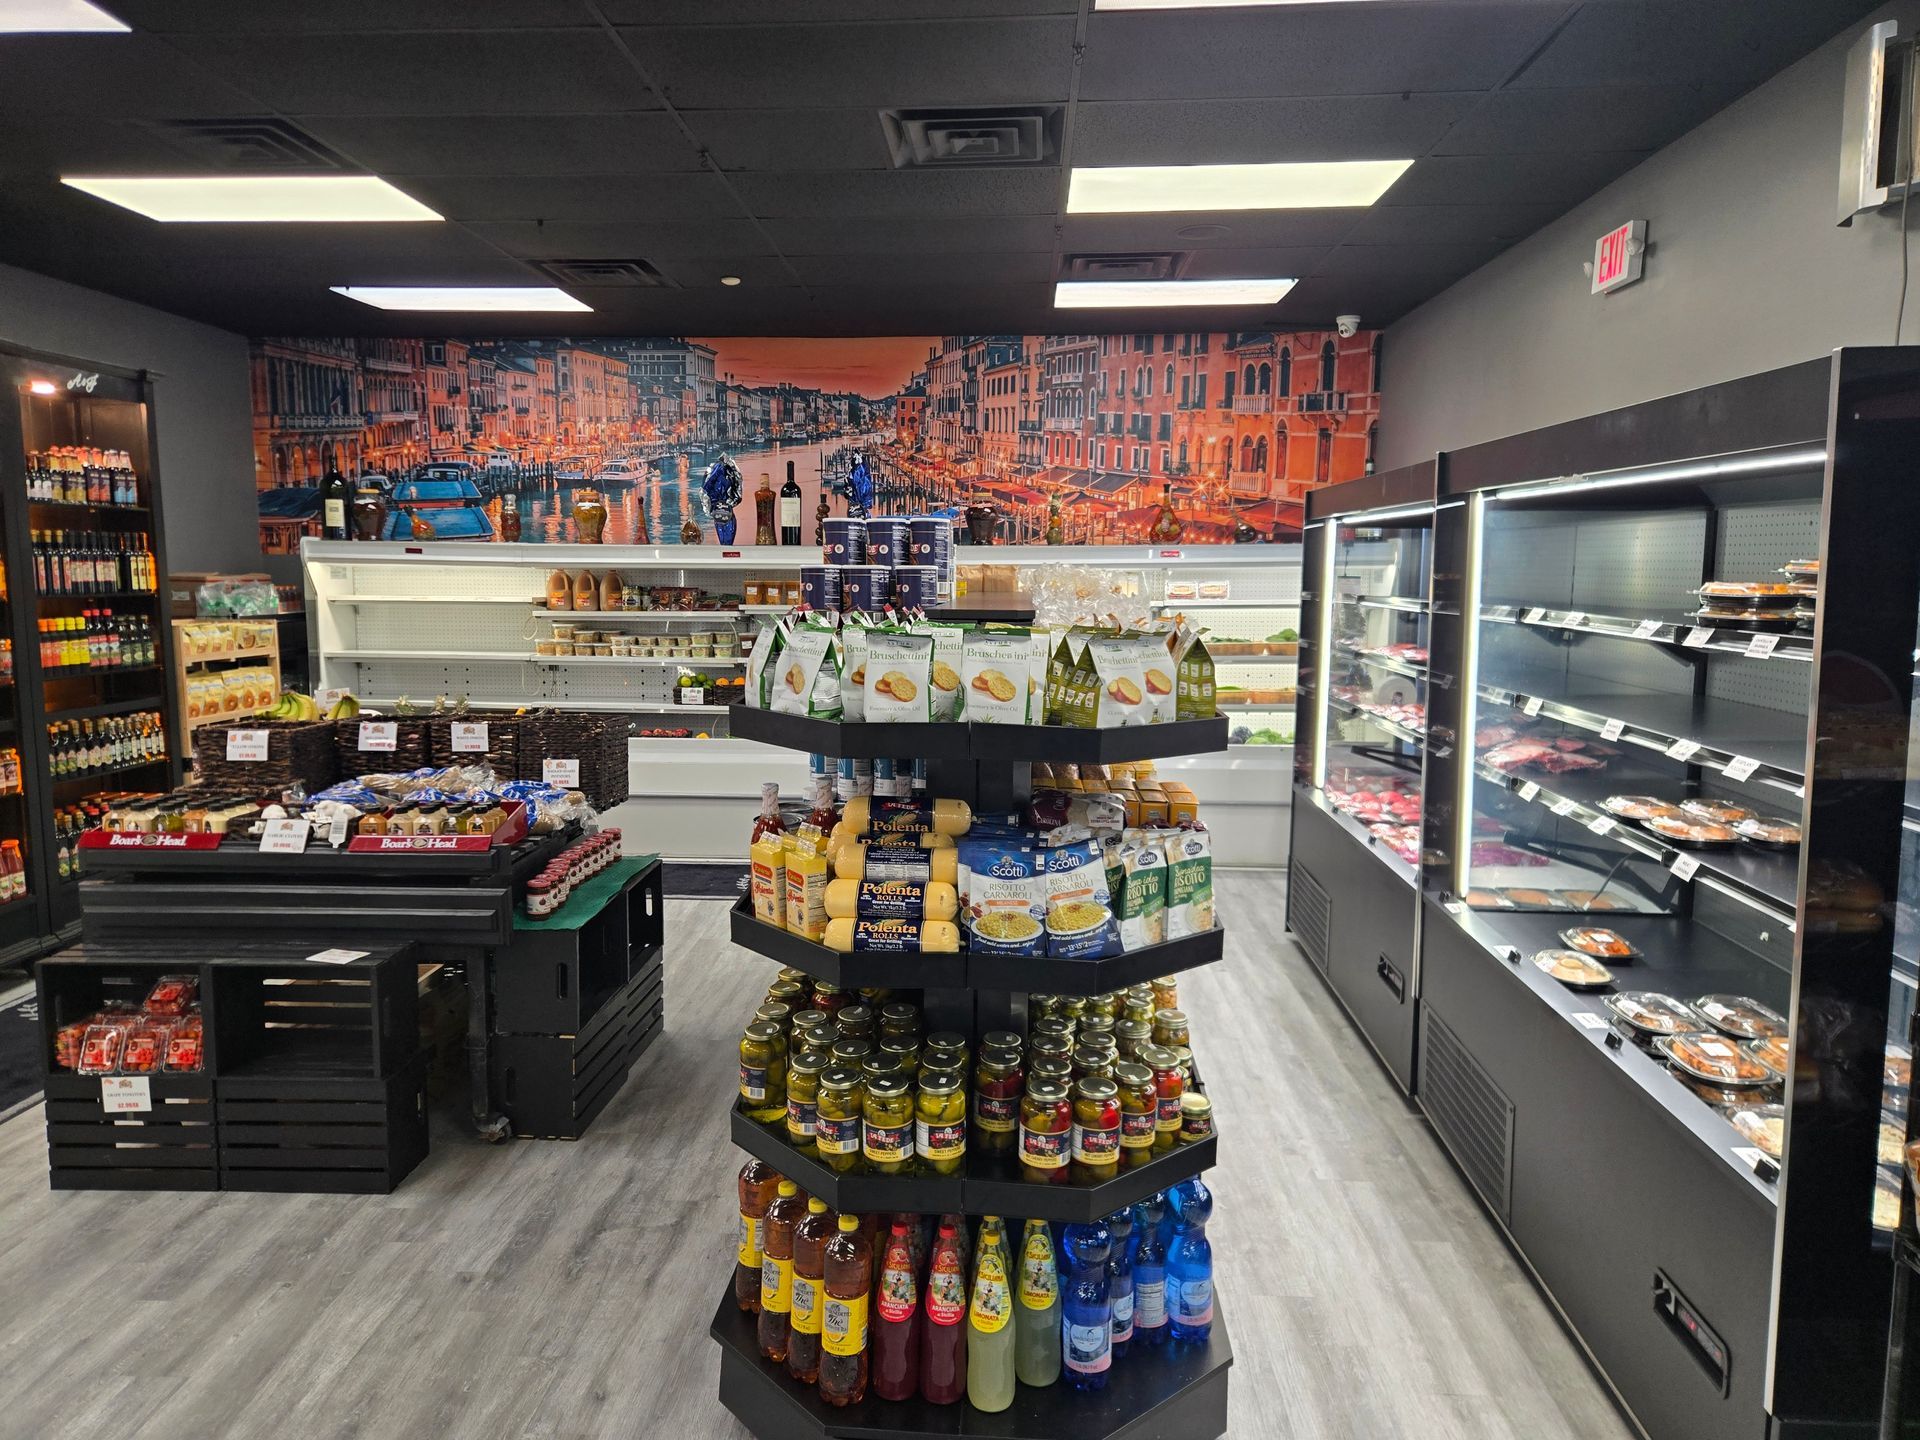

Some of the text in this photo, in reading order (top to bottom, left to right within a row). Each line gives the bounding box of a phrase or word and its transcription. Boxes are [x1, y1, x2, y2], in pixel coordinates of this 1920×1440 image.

[1598, 226, 1628, 284] EXIT
[873, 818, 929, 833] Polenta
[861, 839, 917, 847] Plenta
[1185, 844, 1201, 853] Scotti
[1049, 856, 1080, 871] Scotti
[1138, 853, 1156, 864] Scotti
[992, 865, 1023, 877] Scotti
[1050, 872, 1087, 887] RISOTTO
[1174, 871, 1205, 887] RISOTTO
[755, 882, 775, 895] Polenta
[862, 882, 921, 897] Polenta
[989, 883, 1026, 892] RISOTTO
[1046, 880, 1094, 895] CARNAROLI
[787, 889, 804, 903] Polenta
[983, 891, 1033, 900] CARNAROLI
[858, 922, 918, 934] Polenta
[872, 932, 899, 940] ROLLS
[1024, 1290, 1050, 1298] LIMONATA
[881, 1300, 909, 1310] ARANCIATA
[974, 1311, 999, 1321] LIMONATA
